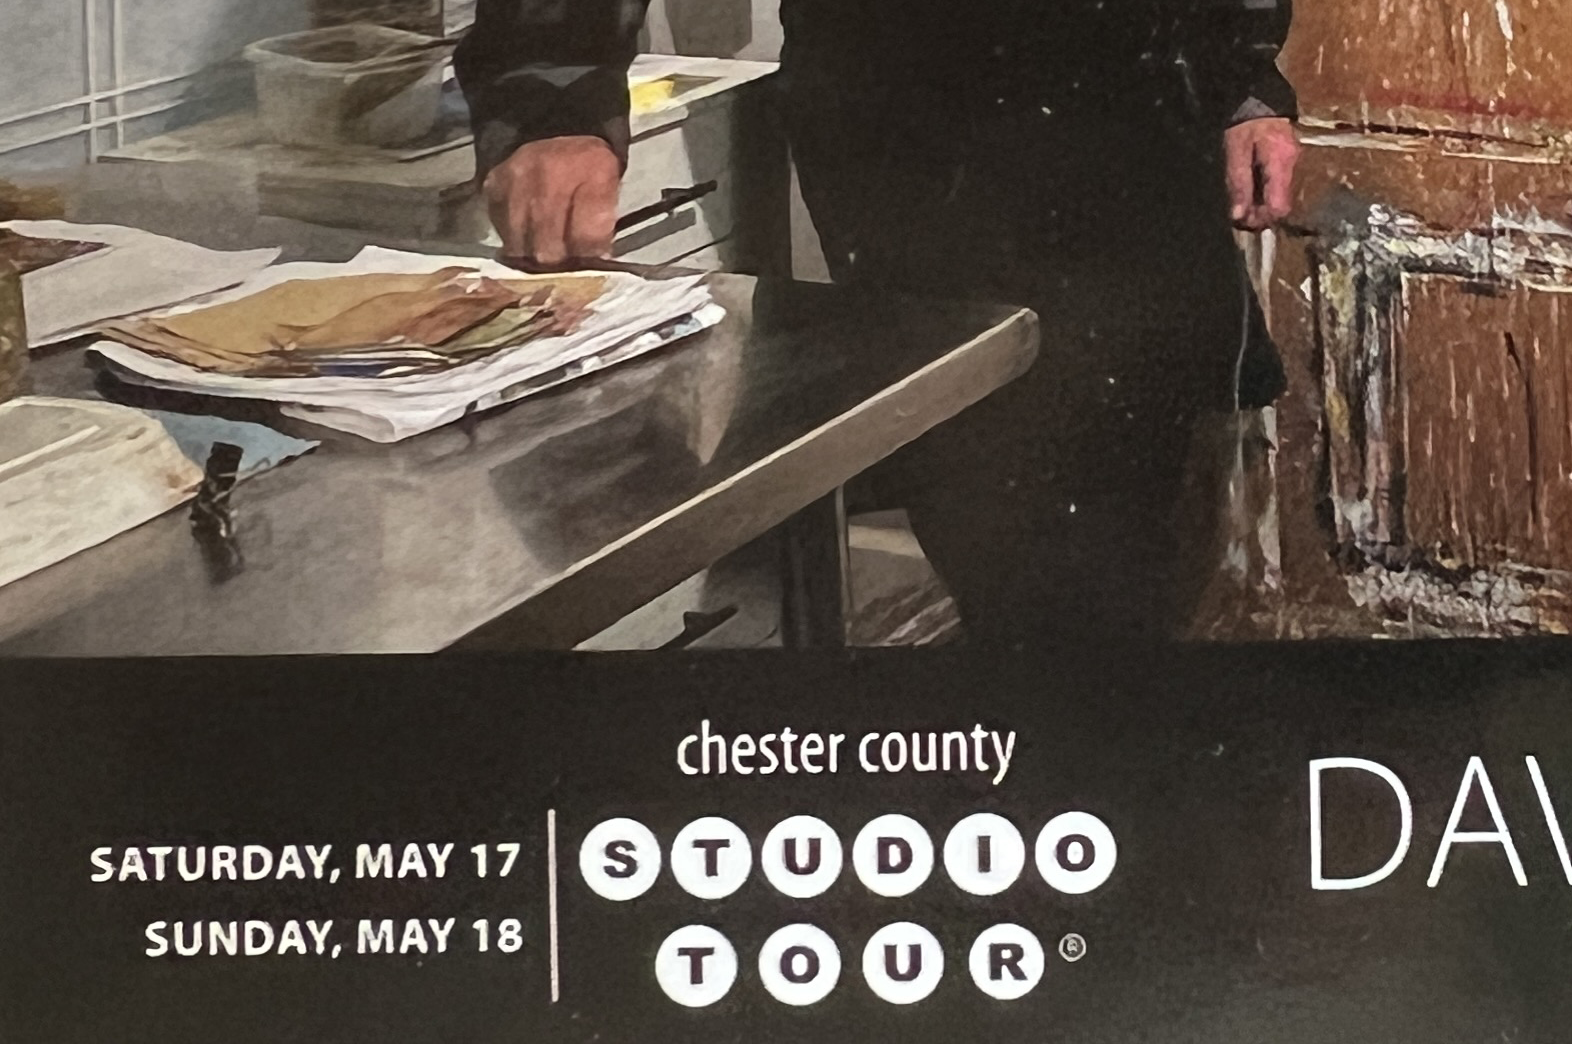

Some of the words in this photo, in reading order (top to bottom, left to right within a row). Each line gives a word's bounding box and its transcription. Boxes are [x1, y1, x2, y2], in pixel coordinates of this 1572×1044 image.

[675, 717, 847, 776] chester
[857, 722, 1018, 787] county
[89, 843, 342, 885] SATURDAY,
[354, 841, 456, 880] MAY
[469, 841, 522, 879] 17
[600, 830, 1099, 882] STUDIO
[143, 918, 343, 960] SUNDAY,
[355, 916, 457, 956] MAY
[471, 917, 524, 954] 18
